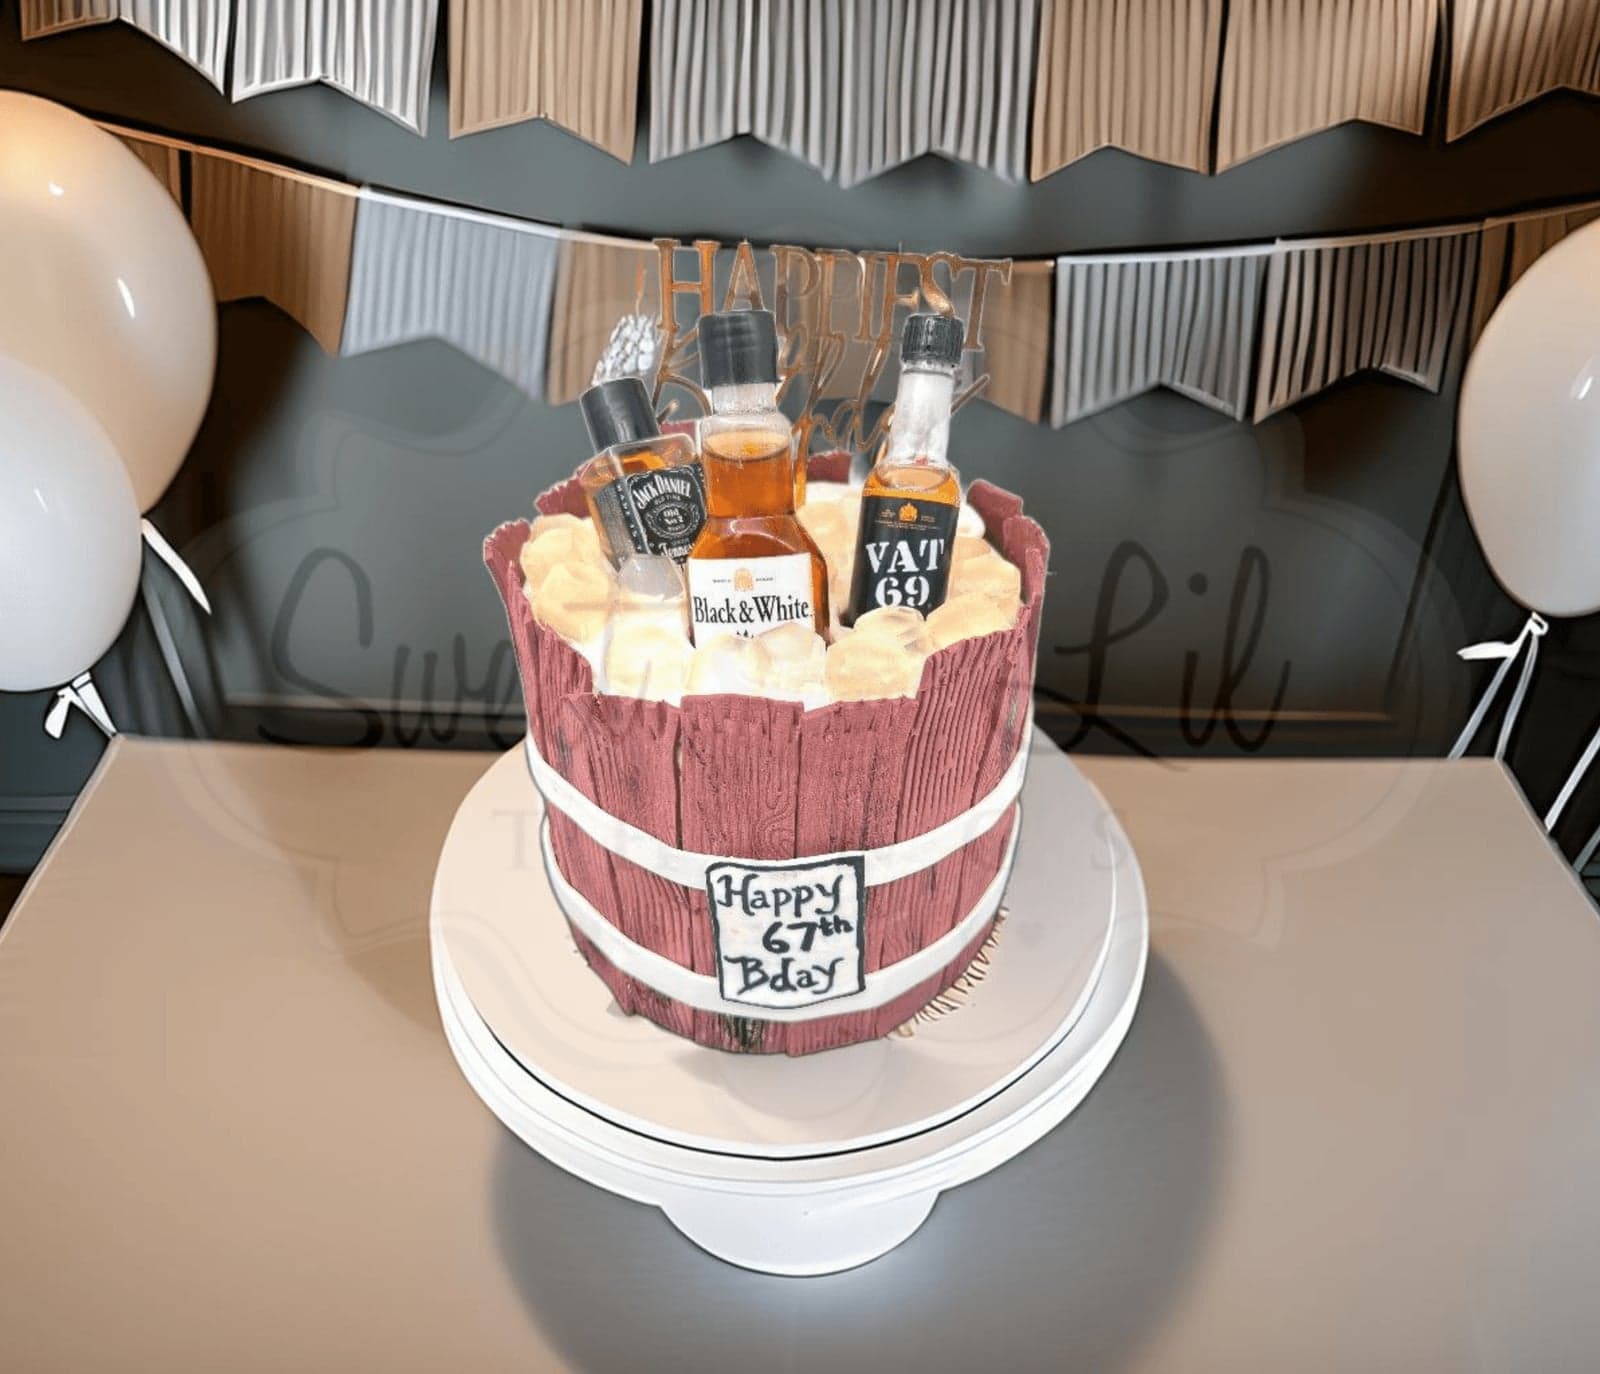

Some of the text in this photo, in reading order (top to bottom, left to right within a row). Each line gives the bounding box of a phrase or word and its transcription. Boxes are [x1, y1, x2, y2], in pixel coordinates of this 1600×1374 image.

[865, 538, 945, 574] VAT
[693, 592, 809, 624] Black & White
[875, 576, 930, 607] 69
[717, 873, 844, 919] Happy
[762, 914, 855, 954] 67th
[723, 955, 845, 996] Bday
